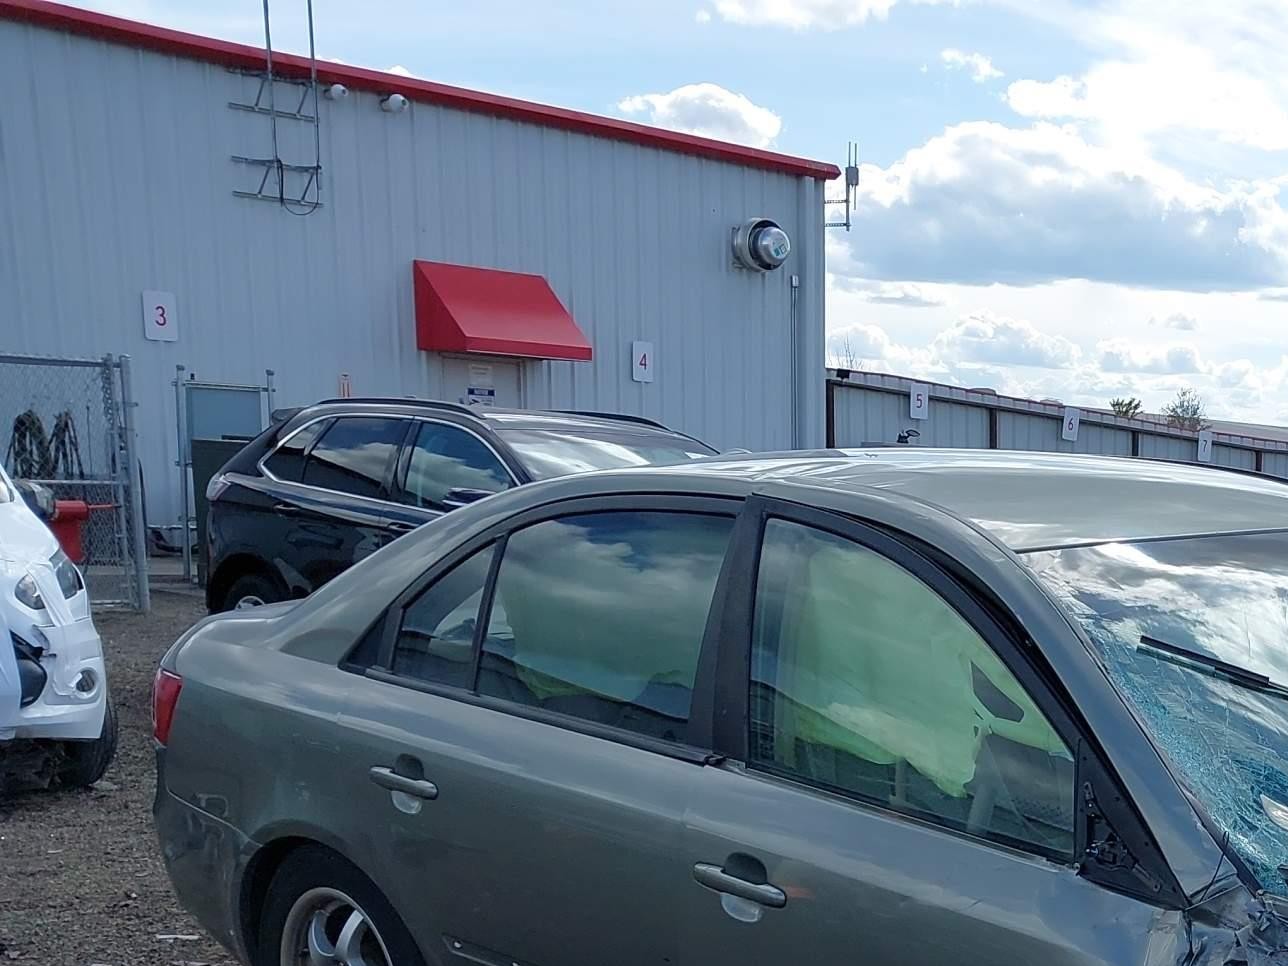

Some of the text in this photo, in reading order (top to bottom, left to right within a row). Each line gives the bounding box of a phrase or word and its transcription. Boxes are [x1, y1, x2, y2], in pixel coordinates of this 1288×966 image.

[154, 305, 167, 327] 3
[639, 352, 648, 371] 4
[916, 393, 923, 409] 5
[1067, 417, 1074, 431] 6
[1203, 439, 1208, 453] 7
